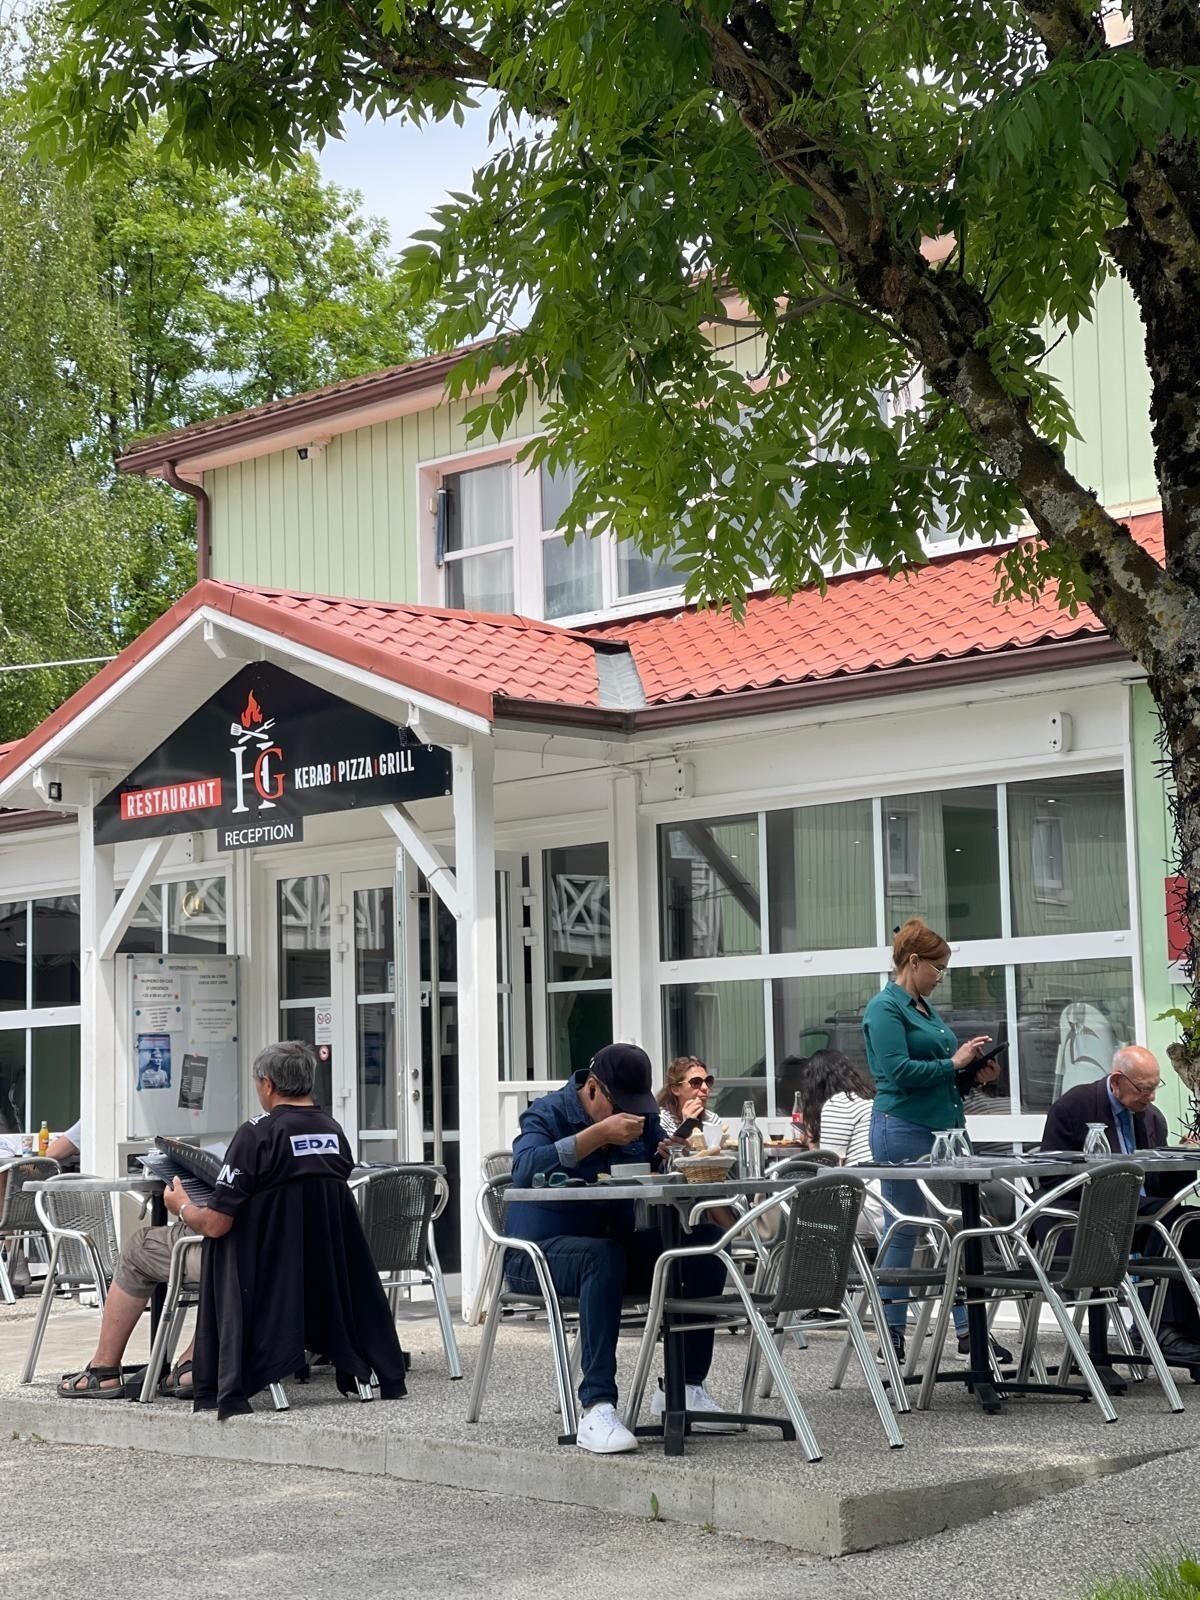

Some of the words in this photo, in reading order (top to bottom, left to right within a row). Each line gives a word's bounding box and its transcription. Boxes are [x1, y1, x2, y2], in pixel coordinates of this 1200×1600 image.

[294, 763, 331, 789] KEBAB
[338, 756, 373, 782] PIZZA
[379, 749, 415, 776] GRILL
[127, 782, 216, 817] RESTAURANT
[225, 824, 294, 846] RECEPTION
[294, 1139, 338, 1151] EDA
